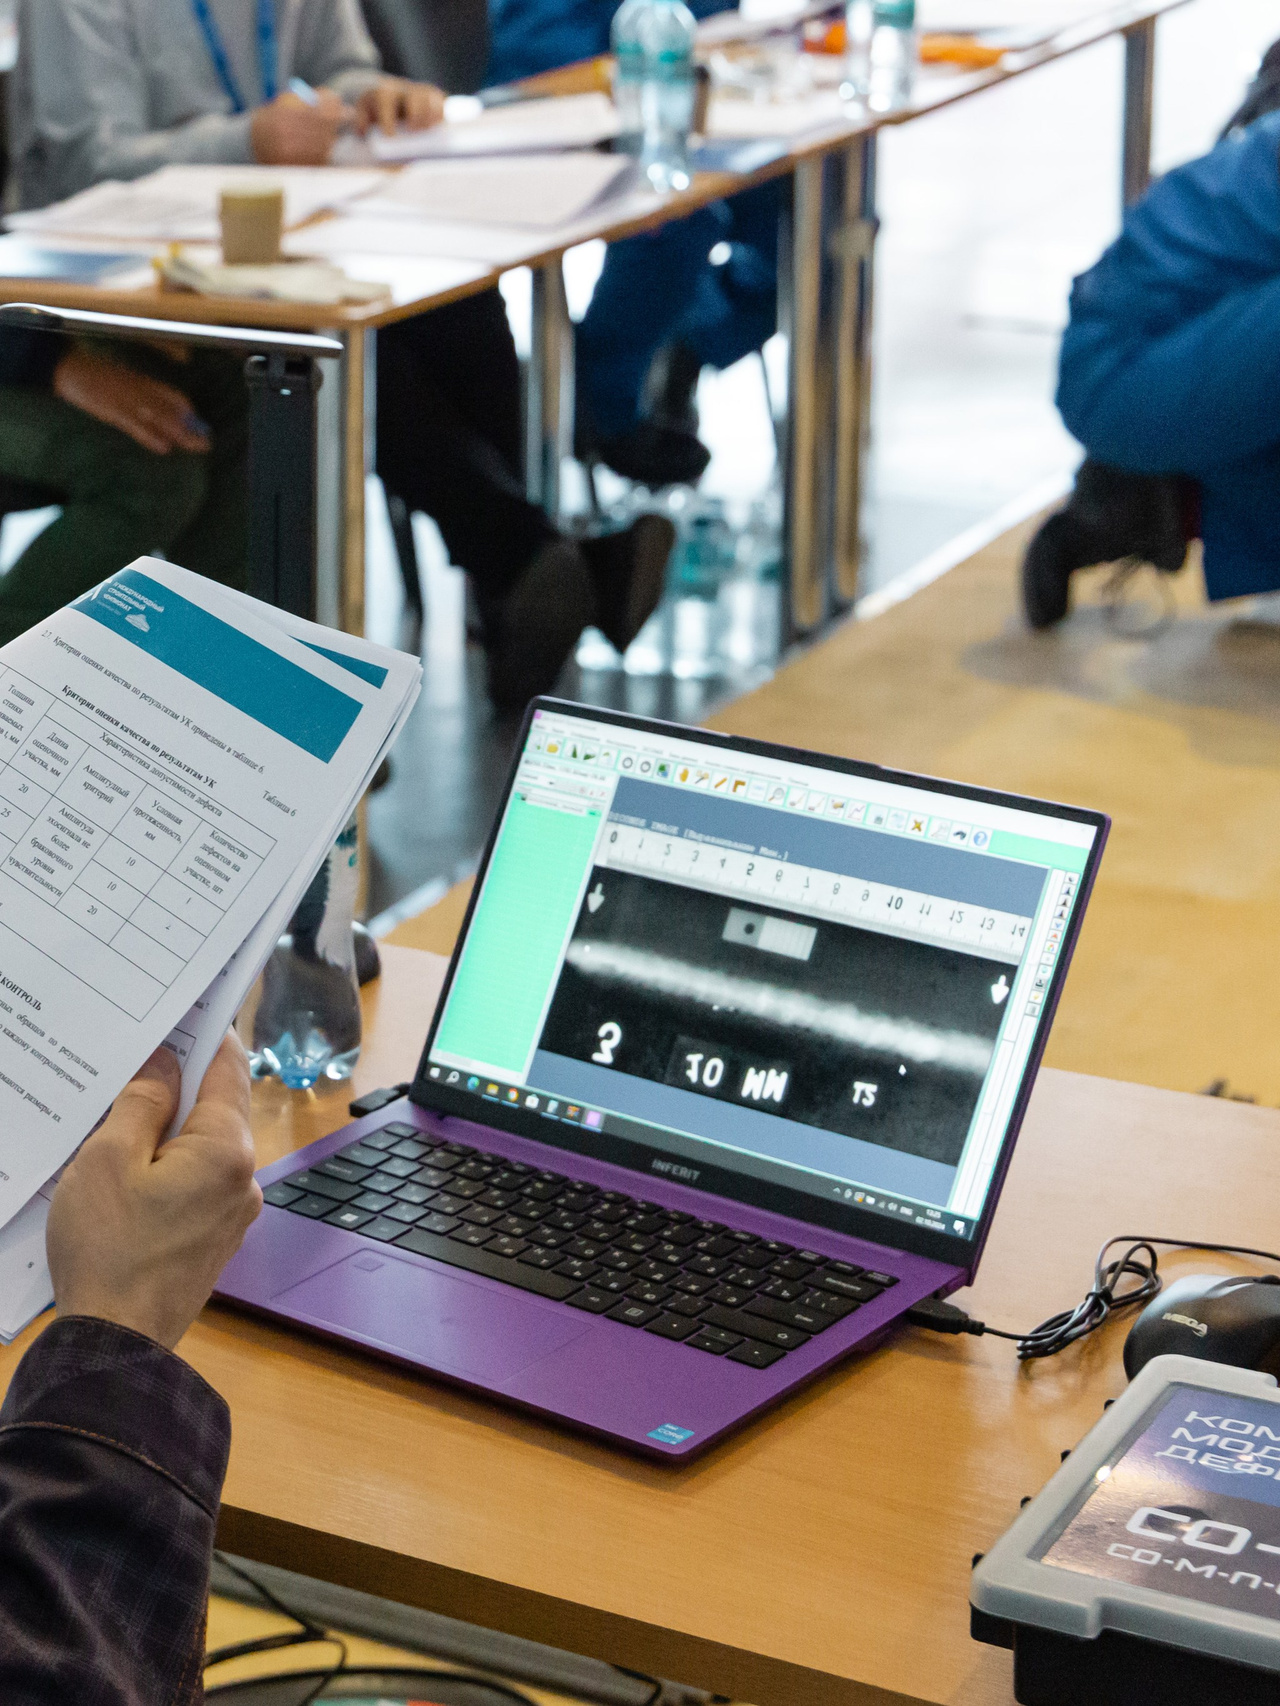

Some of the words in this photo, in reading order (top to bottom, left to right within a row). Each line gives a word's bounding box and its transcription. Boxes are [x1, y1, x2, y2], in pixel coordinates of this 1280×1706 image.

[2, 698, 23, 714] стенки
[7, 683, 35, 706] Толщина
[52, 635, 81, 657] Критерии
[80, 654, 104, 671] оценки
[102, 668, 131, 689] качества
[138, 692, 180, 720] результатам
[190, 724, 227, 750] приведены
[231, 749, 258, 769] таблице
[46, 731, 69, 750] Длина
[61, 684, 95, 710] Критерии
[94, 708, 120, 726] оценки
[119, 723, 150, 746] качества
[150, 744, 160, 752] по
[158, 749, 203, 780] результатам
[203, 776, 216, 788] УК
[21, 749, 48, 770] участка,
[31, 738, 69, 765] оценочного
[82, 764, 130, 797] Амплитудный
[98, 730, 150, 770] Характеристика
[148, 766, 196, 799] допустимости
[194, 796, 222, 816] дефекта
[18, 783, 28, 793] 20
[82, 780, 114, 804] критерий
[262, 789, 290, 813] Таблица
[0, 807, 11, 817] 25
[58, 807, 94, 835] Амплитуда
[132, 806, 181, 843] протяженность,
[151, 799, 183, 825] Условная
[46, 816, 82, 843] эхосигнала
[50, 834, 70, 851] более
[30, 836, 73, 870] браковочного
[199, 842, 231, 866] дефектов
[208, 829, 248, 860] Количество
[30, 856, 55, 874] уровня
[125, 857, 135, 866] 10
[193, 855, 231, 882] оценочном
[8, 855, 63, 897] чувствительности
[106, 881, 116, 890] 10
[182, 865, 211, 888] участке,
[87, 905, 97, 914] 20
[0, 976, 41, 1010] КОНТРОЛЬ
[16, 1013, 45, 1037] образцов
[57, 1045, 99, 1076] результатам
[1, 1027, 31, 1051] каждому
[29, 1047, 86, 1092] контролируемому
[22, 1092, 52, 1115] размеры
[652, 1159, 700, 1182] INFERIT
[1154, 1444, 1280, 1481] ДЕФ
[1106, 1542, 1280, 1596] СО-М-П-
